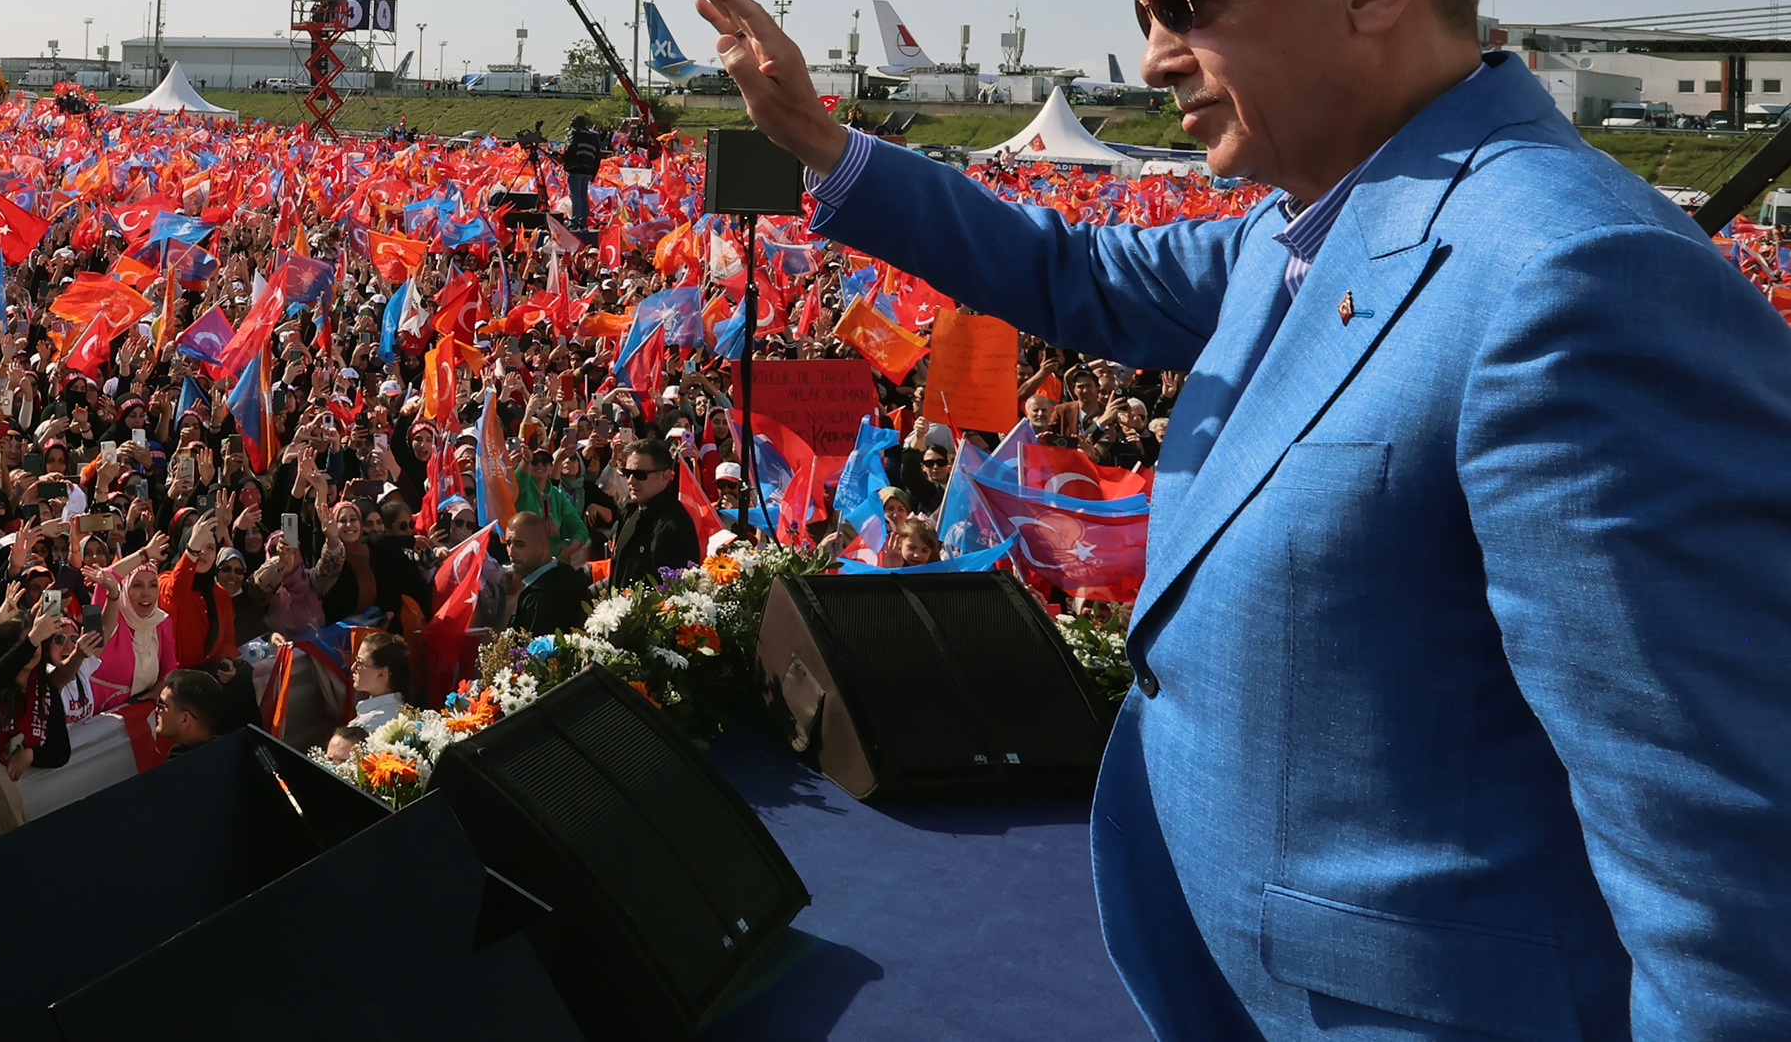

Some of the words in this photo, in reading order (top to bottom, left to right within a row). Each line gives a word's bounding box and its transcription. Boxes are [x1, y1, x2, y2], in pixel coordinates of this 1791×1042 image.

[347, 6, 355, 20] 4
[382, 7, 388, 21] 4
[654, 39, 676, 58] XL
